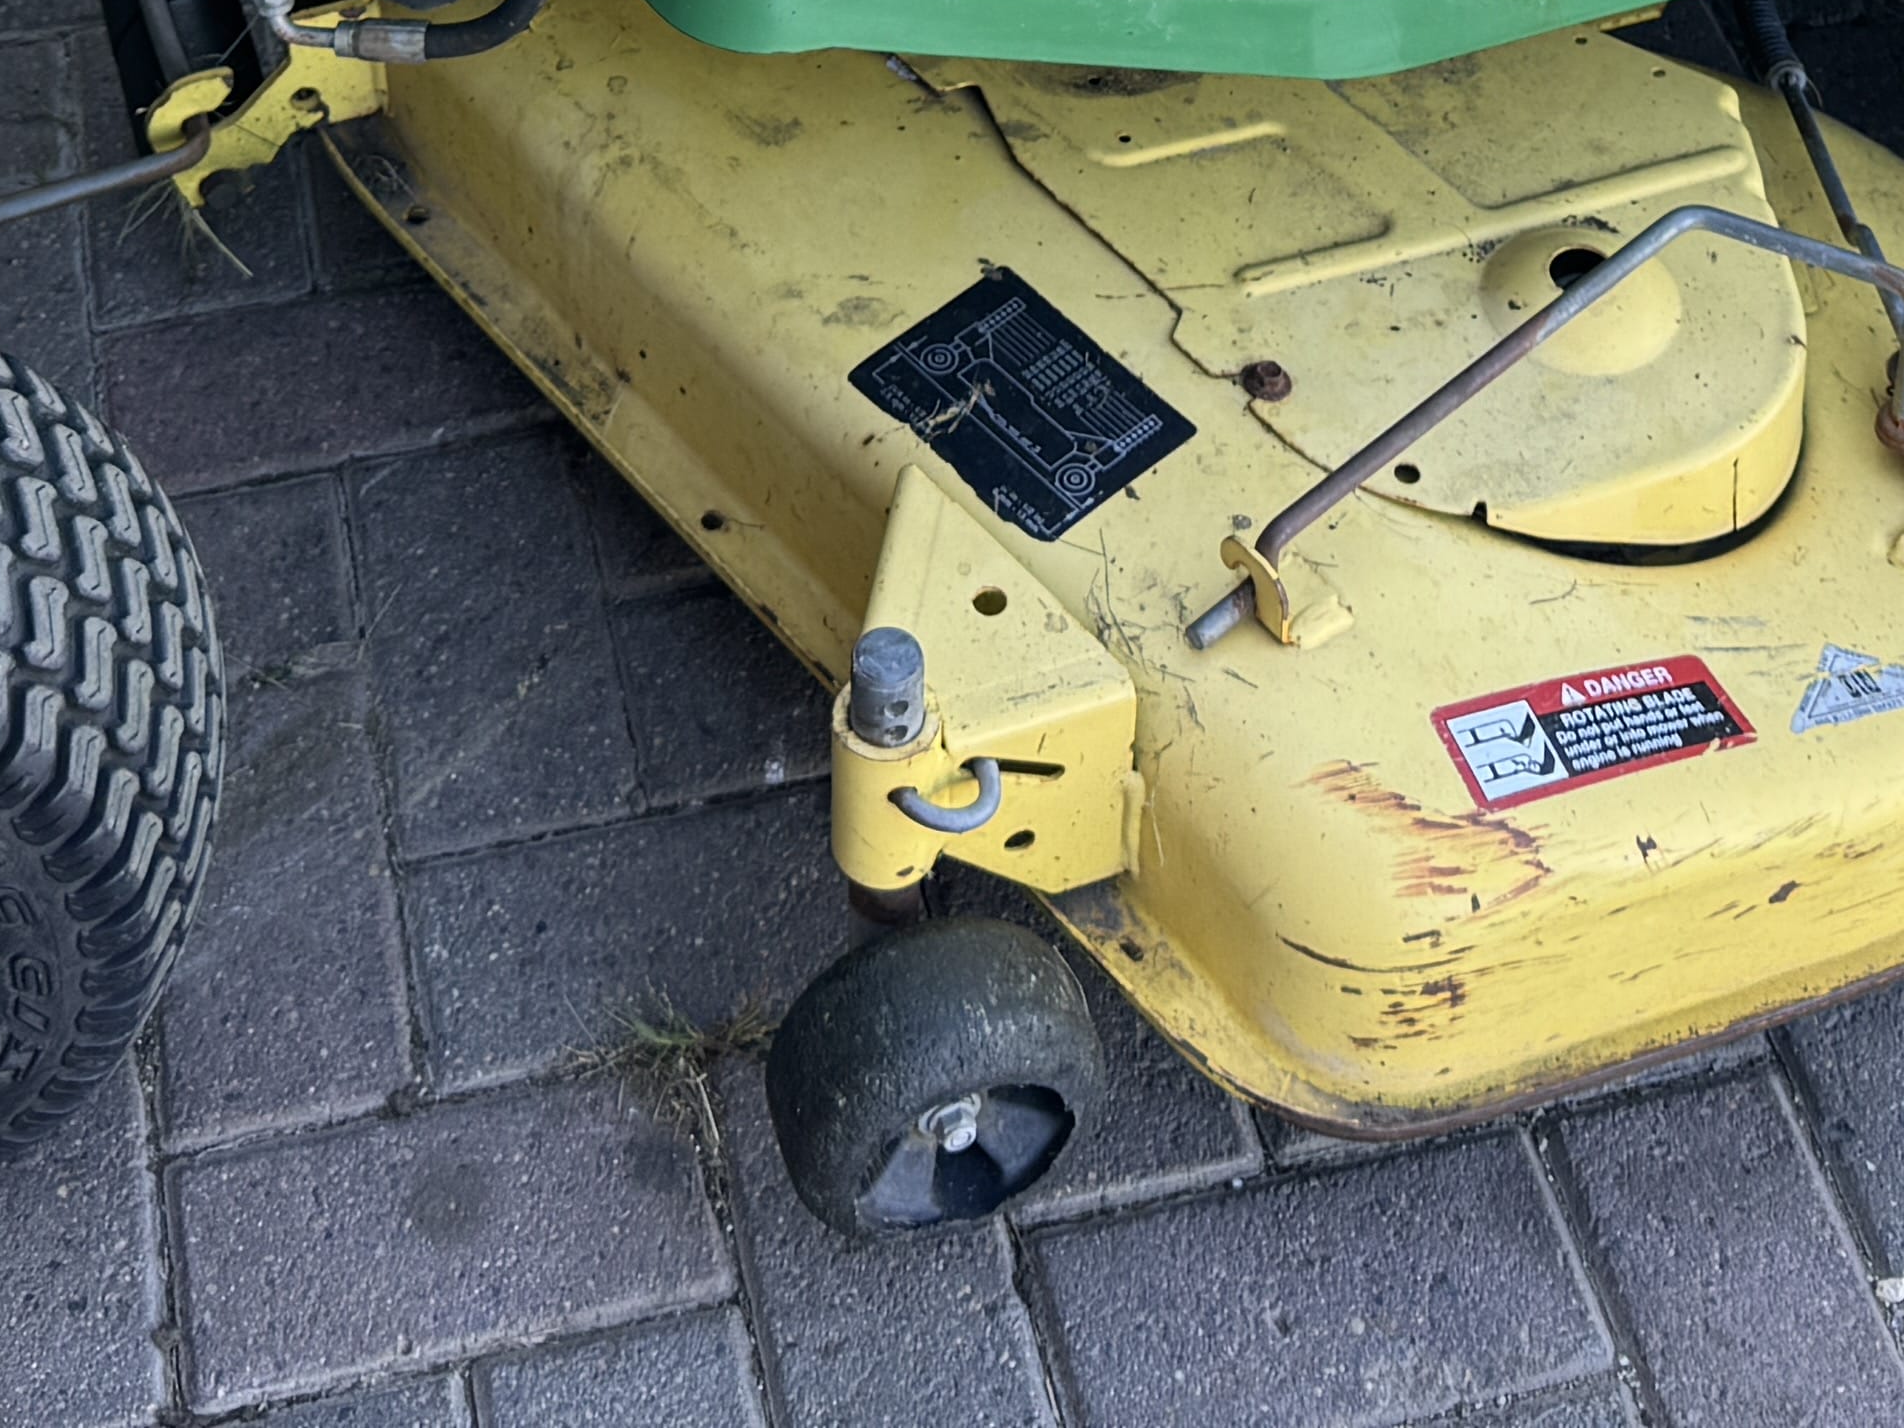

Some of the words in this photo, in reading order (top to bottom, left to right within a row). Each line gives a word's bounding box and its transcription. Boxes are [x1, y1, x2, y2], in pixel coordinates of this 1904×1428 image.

[1581, 665, 1675, 697] DANGER
[1553, 728, 1579, 745] Do
[1575, 722, 1603, 740] not
[1599, 717, 1626, 734] put
[1622, 708, 1665, 729] hands
[1559, 698, 1644, 727] ROTATING
[1640, 686, 1697, 709] BLADE
[1561, 737, 1605, 758] under
[1618, 727, 1648, 744] into
[1645, 717, 1691, 738] mower
[1688, 708, 1726, 727] when
[1569, 748, 1618, 772] engine
[1629, 731, 1685, 756] running
